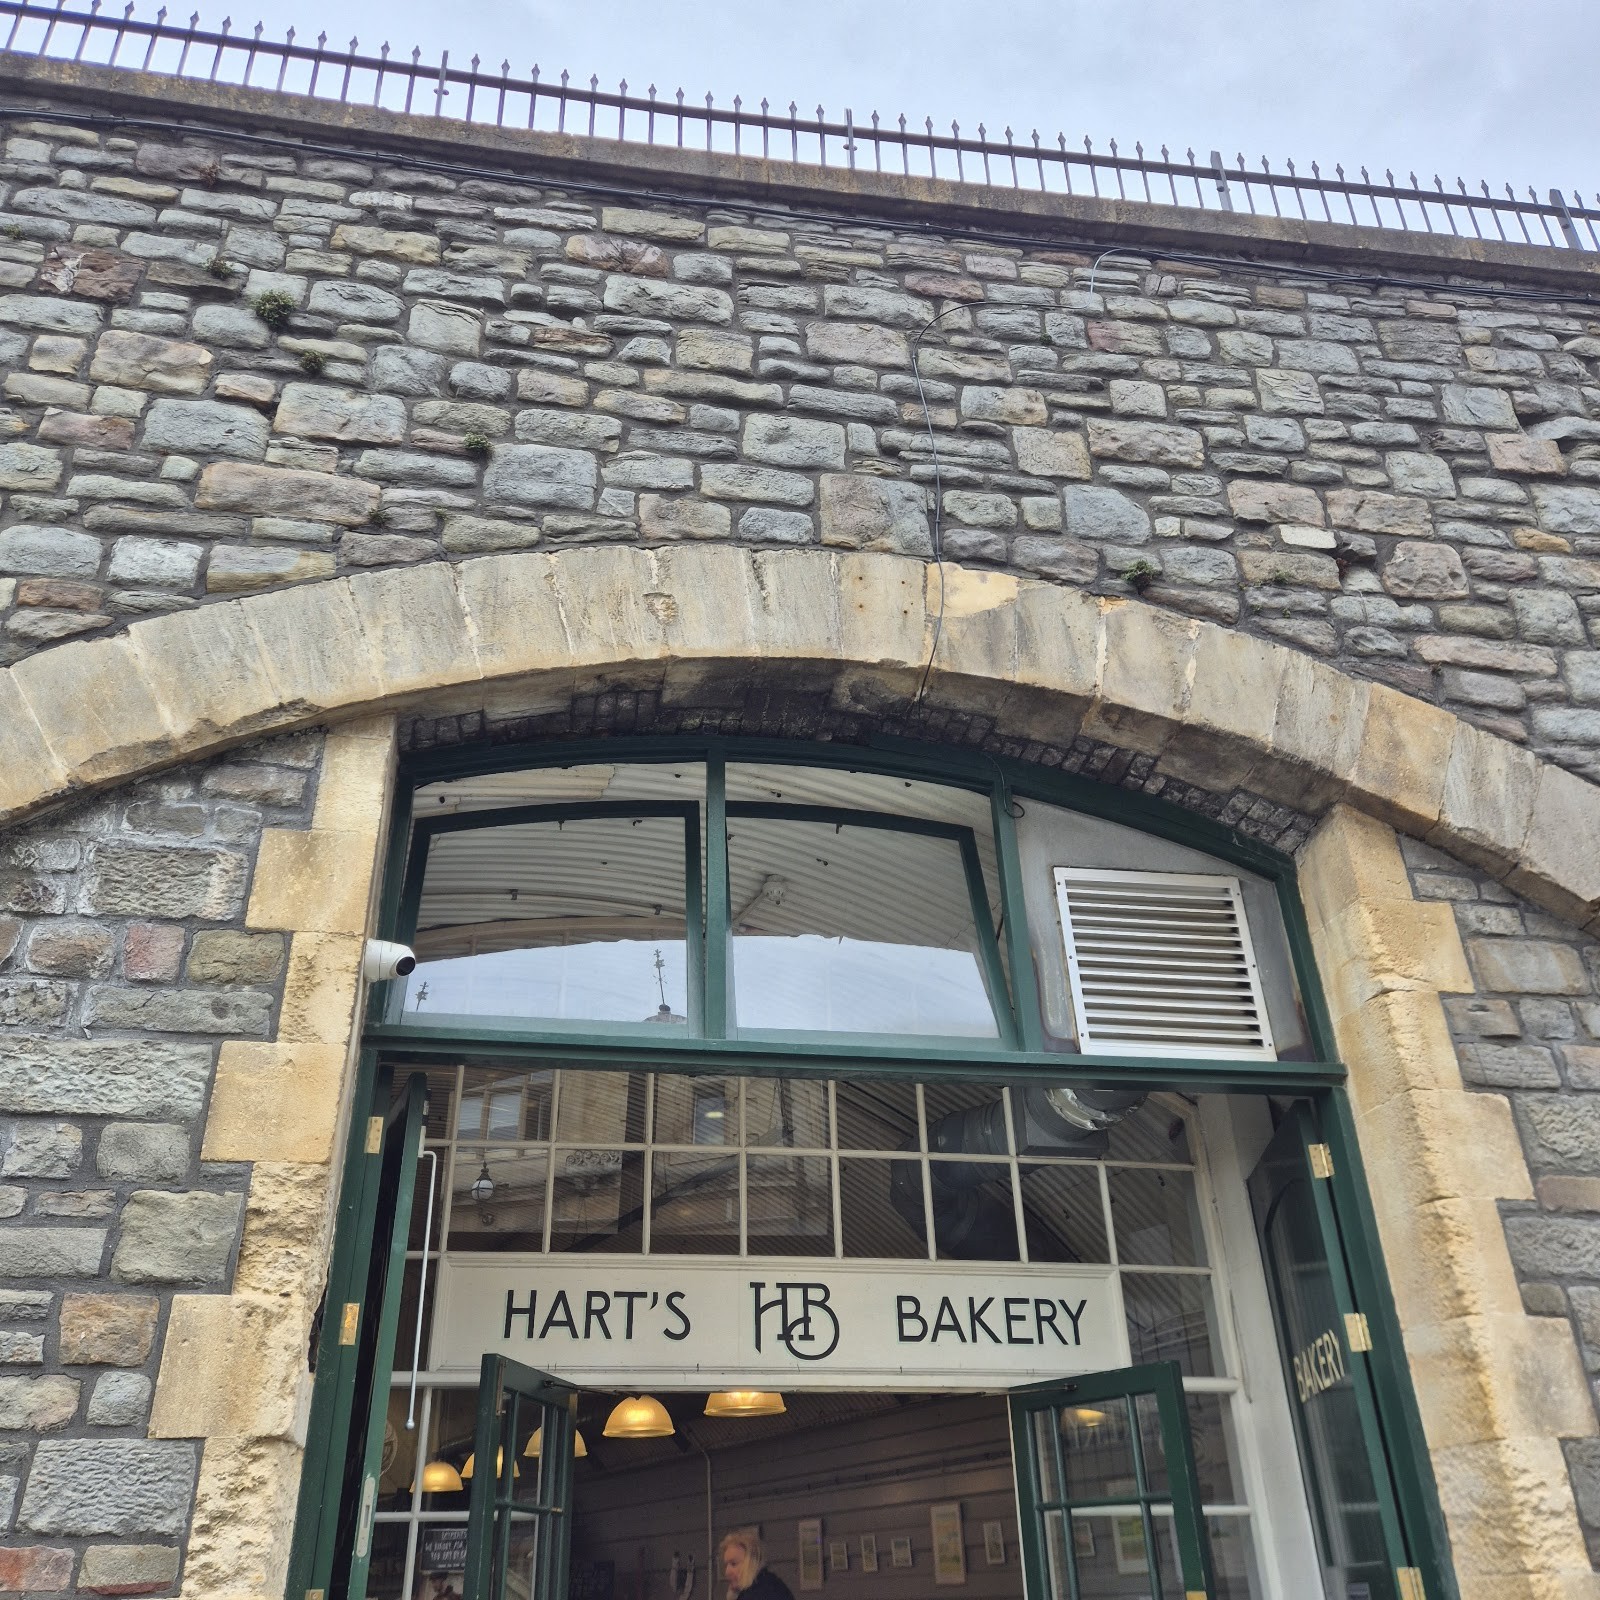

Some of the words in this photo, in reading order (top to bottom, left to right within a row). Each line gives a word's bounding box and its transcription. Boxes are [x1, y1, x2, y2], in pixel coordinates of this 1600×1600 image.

[504, 1290, 690, 1340] HART'S
[897, 1296, 1087, 1345] BAKERY
[1292, 1328, 1345, 1403] BAKERY
